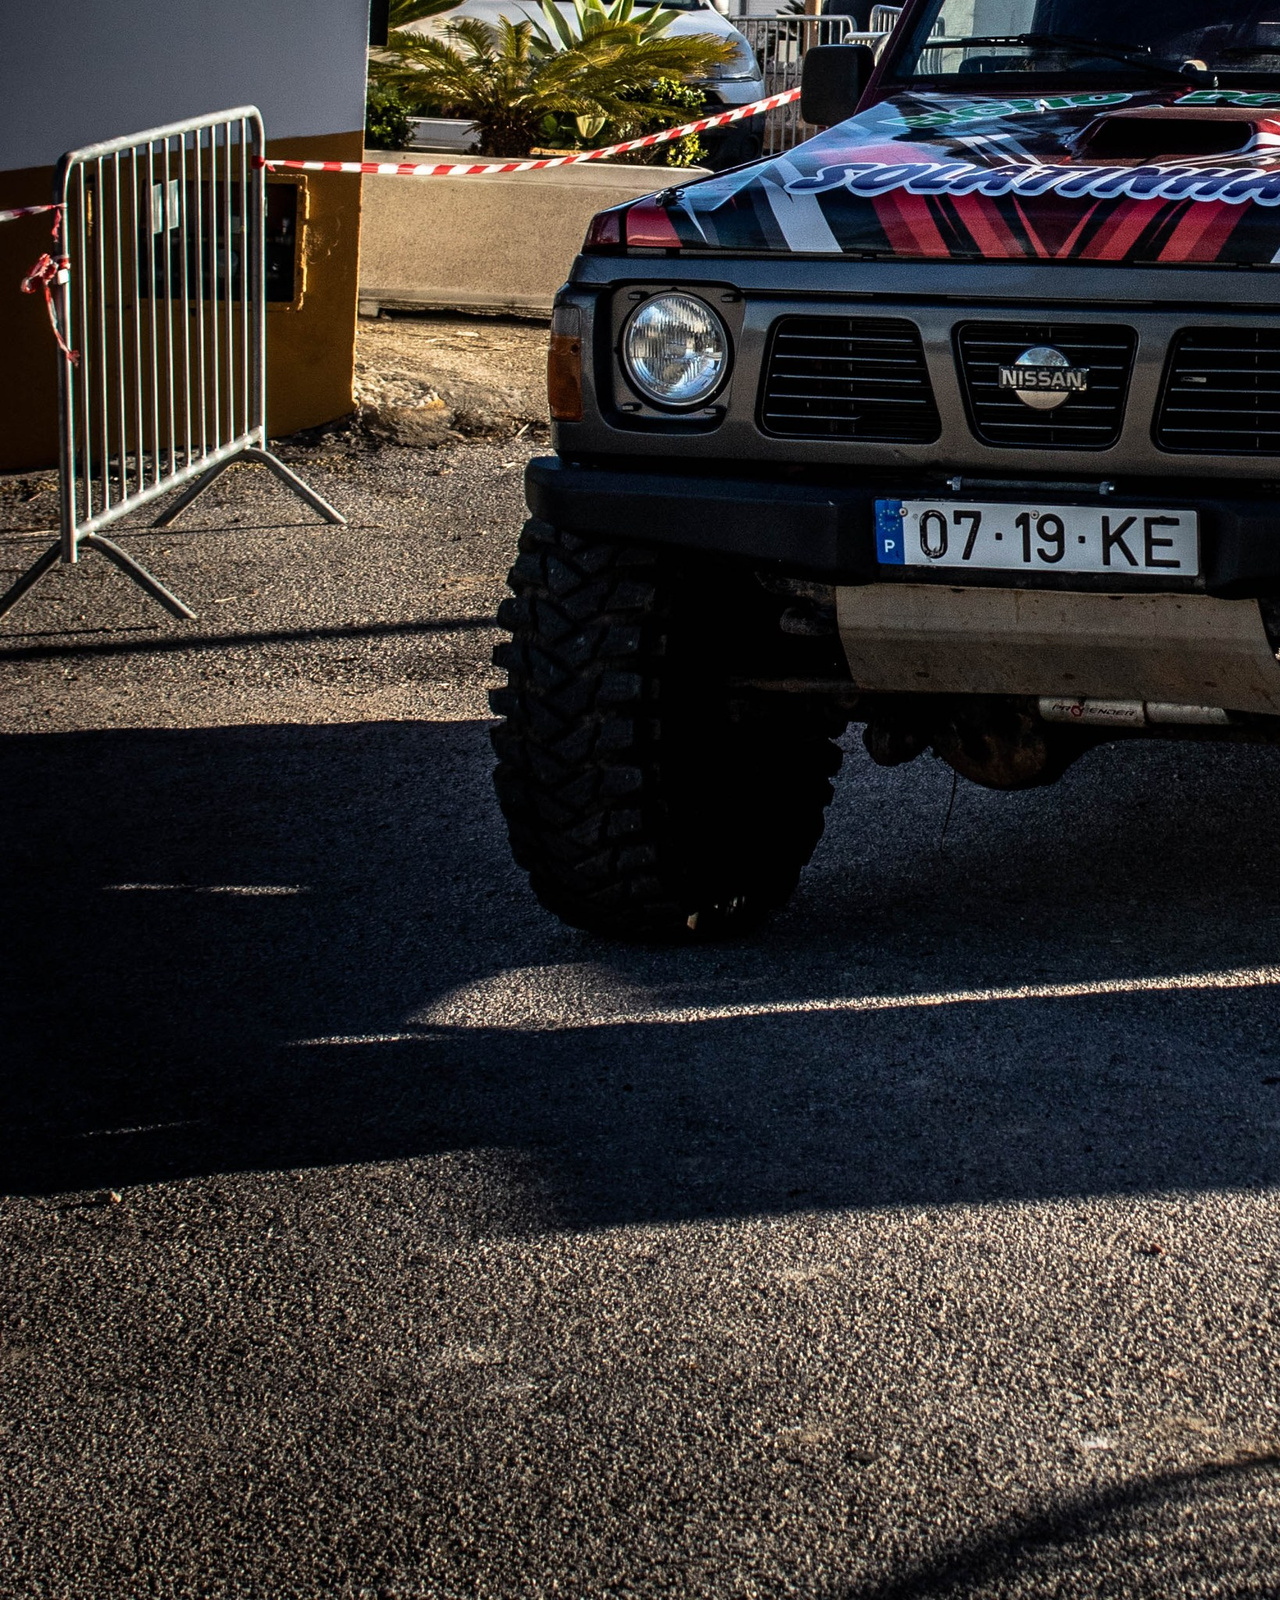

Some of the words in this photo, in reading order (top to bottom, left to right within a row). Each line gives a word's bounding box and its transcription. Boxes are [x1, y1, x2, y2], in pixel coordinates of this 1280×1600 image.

[1002, 369, 1082, 387] NISSAN
[884, 539, 895, 553] P
[1051, 704, 1137, 718] PROENDER
